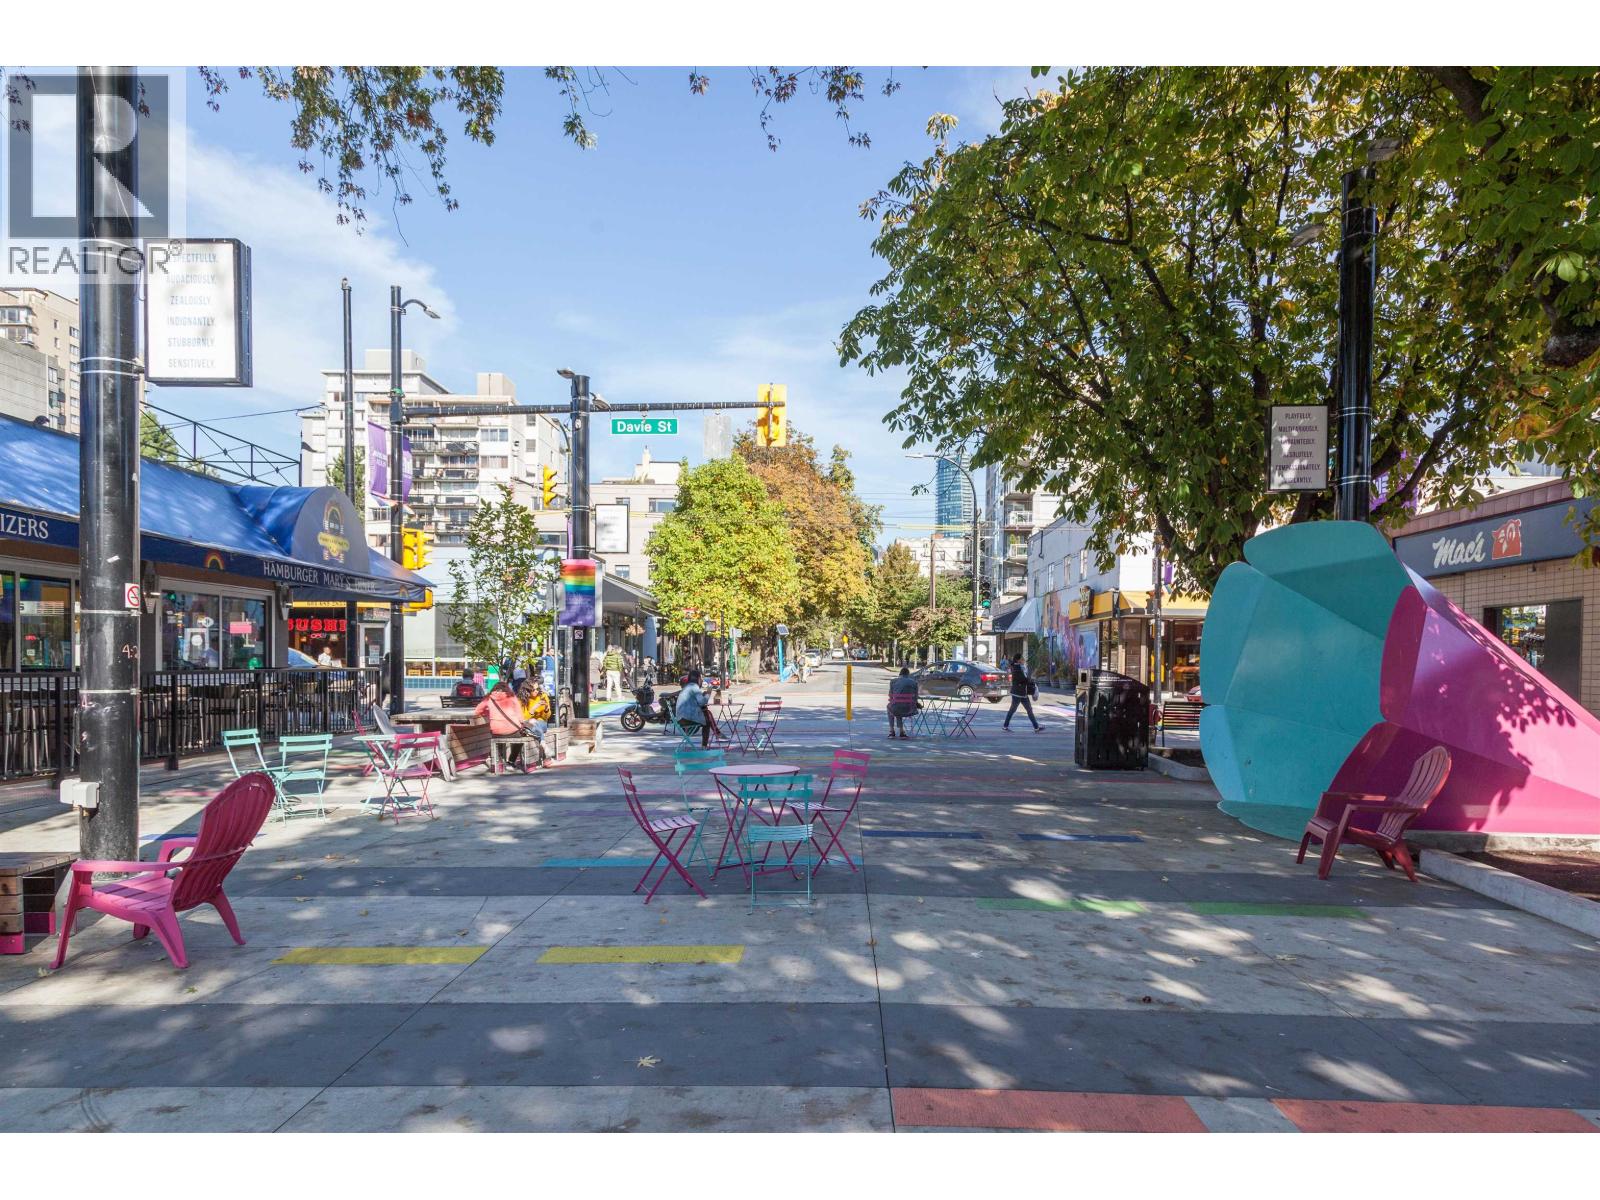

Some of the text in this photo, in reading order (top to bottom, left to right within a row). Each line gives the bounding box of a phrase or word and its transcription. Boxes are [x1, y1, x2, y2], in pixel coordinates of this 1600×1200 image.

[617, 421, 672, 433] Davie St
[1432, 531, 1486, 569] Mac's
[263, 560, 319, 584] HAMBURGER
